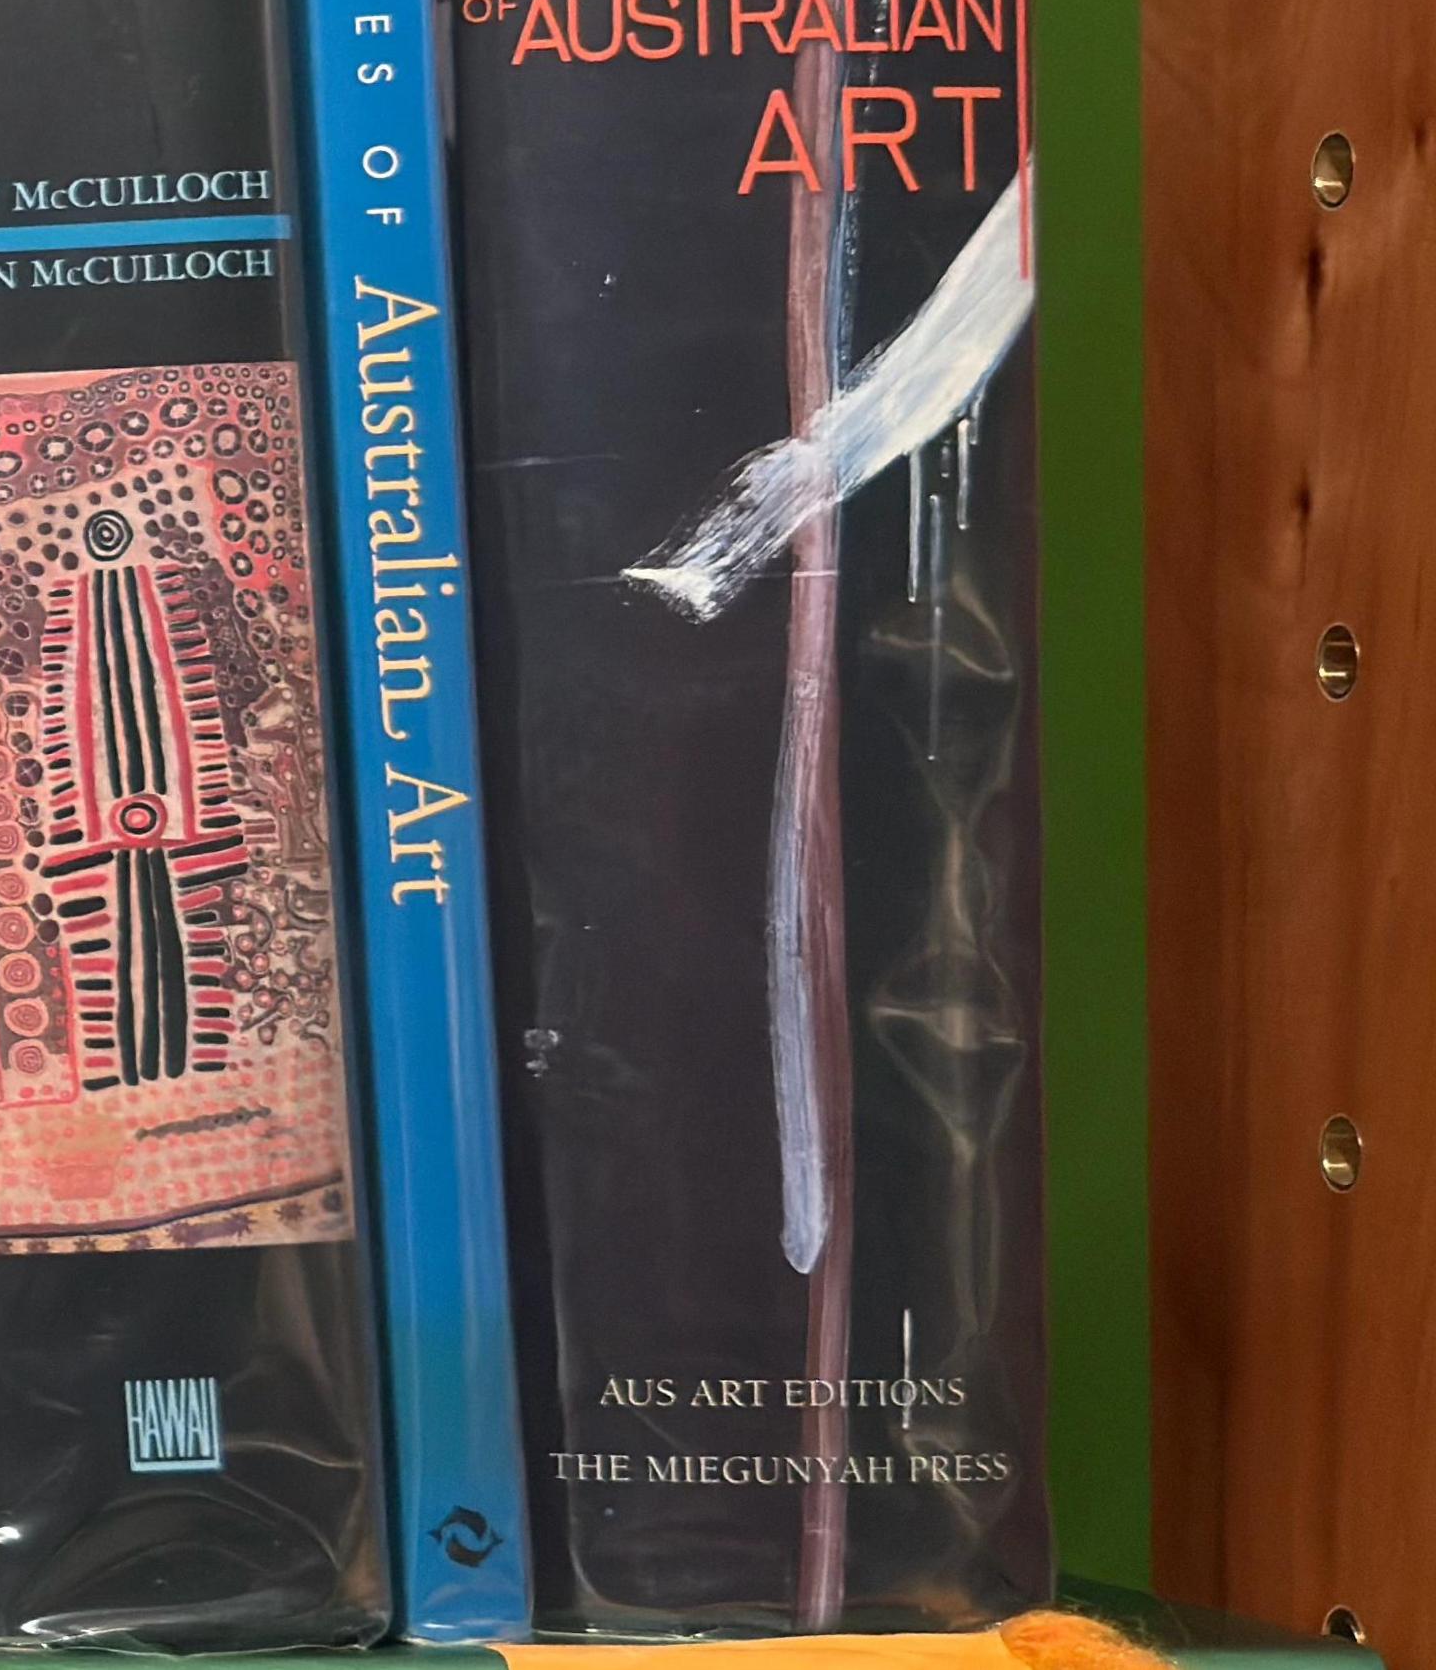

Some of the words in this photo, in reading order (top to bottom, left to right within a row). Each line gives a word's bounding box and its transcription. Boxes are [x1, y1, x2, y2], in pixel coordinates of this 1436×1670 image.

[737, 86, 1002, 196] ART
[12, 170, 271, 211] McCULLOCH
[360, 143, 403, 226] OF
[31, 249, 275, 289] McCULLOCH
[356, 275, 459, 742] Australian
[385, 761, 472, 908] Art
[600, 1378, 677, 1407] AUS
[691, 1379, 768, 1407] ART
[785, 1377, 965, 1407] EDITIONS
[549, 1452, 631, 1482] THE
[646, 1455, 893, 1485] MIEGUNYAH
[909, 1453, 1009, 1483] PRESS
